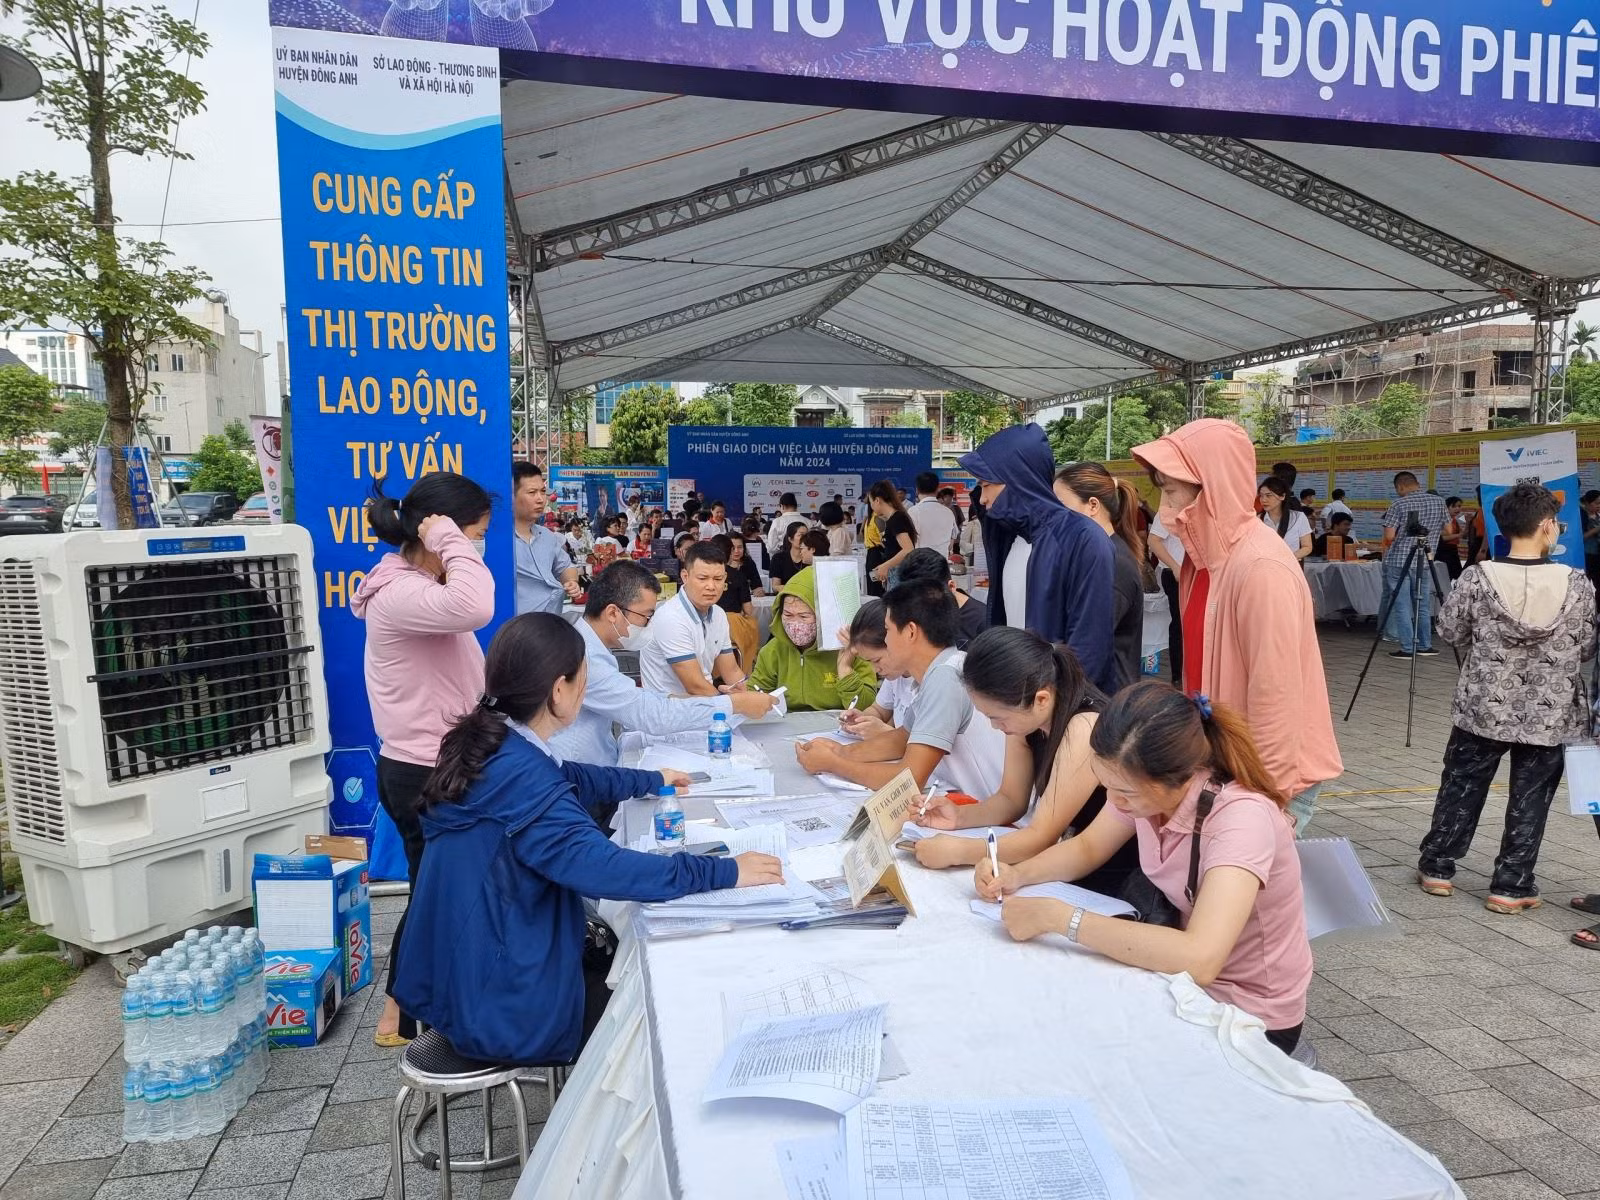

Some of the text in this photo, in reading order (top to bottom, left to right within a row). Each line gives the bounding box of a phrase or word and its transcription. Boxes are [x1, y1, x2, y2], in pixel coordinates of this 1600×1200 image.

[290, 49, 309, 63] BAN
[312, 49, 338, 66] NHÂN
[339, 51, 358, 67] DÂN
[373, 53, 385, 70] SỞ
[387, 58, 405, 72] LAO
[406, 57, 431, 76] ĐỘNG
[438, 62, 475, 78] THƯƠNG
[477, 65, 497, 79] BINH
[1052, 0, 1243, 88] HOẠT
[1256, 0, 1441, 100] ĐỘNG
[1460, 18, 1600, 108] PHIÊ
[278, 66, 358, 86] HUYỆN ĐÔNG ANH
[399, 76, 474, 97] VÀ XÃ HỘI HÀ NỘI
[312, 169, 475, 220] CUNG CẤP
[309, 234, 483, 287] THÔNG TIN
[301, 303, 497, 357] THỊ TRƯỜNG
[317, 369, 487, 425] LAO ĐỘNG,
[346, 431, 463, 480] TƯ VẤN
[687, 441, 918, 456] PHIÊN GIAO DỊCH VIỆC LÀM HUYỆN ĐÔNG ANH
[780, 455, 831, 467] NĂM 2024
